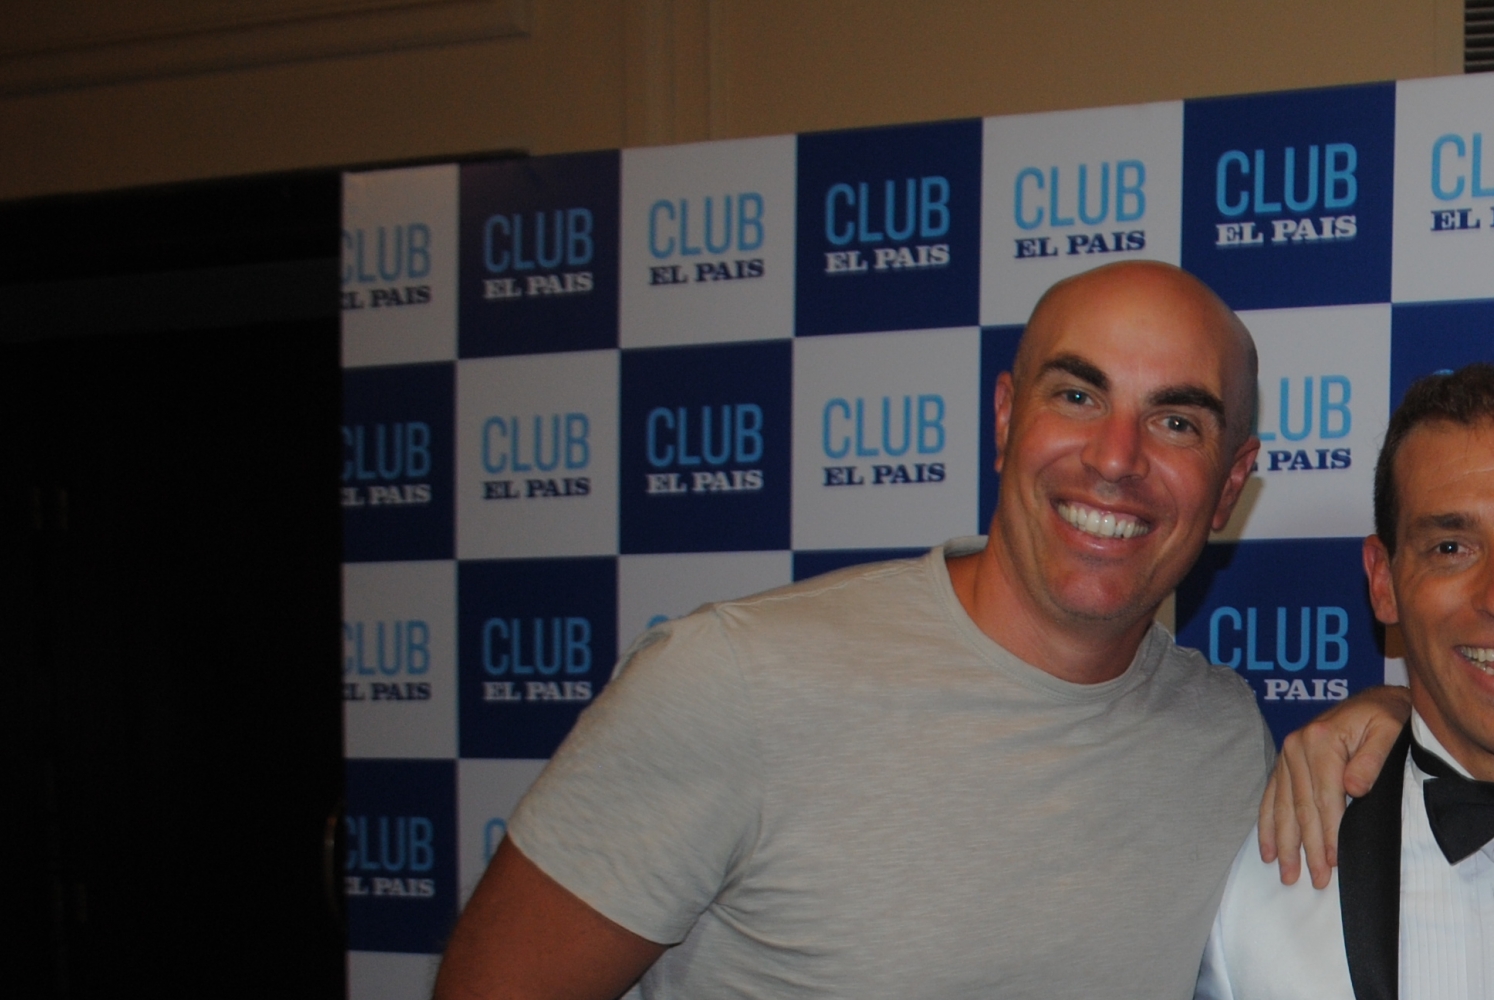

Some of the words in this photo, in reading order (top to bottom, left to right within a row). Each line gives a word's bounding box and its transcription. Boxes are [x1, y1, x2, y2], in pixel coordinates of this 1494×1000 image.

[1216, 143, 1358, 216] CLUB
[1014, 160, 1146, 230] CLUB
[825, 176, 951, 246] CLUB
[1431, 209, 1480, 231] EL
[484, 208, 593, 272] CLUB
[649, 193, 764, 260] CLUB
[1216, 223, 1264, 246] EL
[1271, 216, 1357, 242] PAIS
[1014, 238, 1058, 258] EL
[1067, 231, 1145, 254] PAIS
[825, 251, 868, 273] EL
[874, 244, 950, 269] PAIS
[484, 279, 523, 299] EL
[529, 273, 593, 296] PAIS
[649, 265, 690, 286] EL
[694, 259, 764, 282] PAIS
[370, 285, 431, 308] PAIS
[646, 404, 764, 468] CLUB
[822, 394, 945, 459] CLUB
[482, 412, 590, 474] CLUB
[1267, 448, 1352, 471] PAIS
[646, 472, 689, 494] EL
[693, 470, 763, 492] PAIS
[823, 467, 865, 486] EL
[872, 463, 945, 484] PAIS
[368, 483, 432, 505] PAIS
[483, 480, 523, 500] EL
[528, 477, 590, 499] PAIS
[482, 617, 592, 676] CLUB
[1209, 606, 1349, 672] CLUB
[371, 683, 431, 701] PAIS
[482, 682, 521, 701] EL
[527, 682, 592, 701] PAIS
[1263, 678, 1349, 701] PAIS
[372, 877, 435, 897] PAIS
